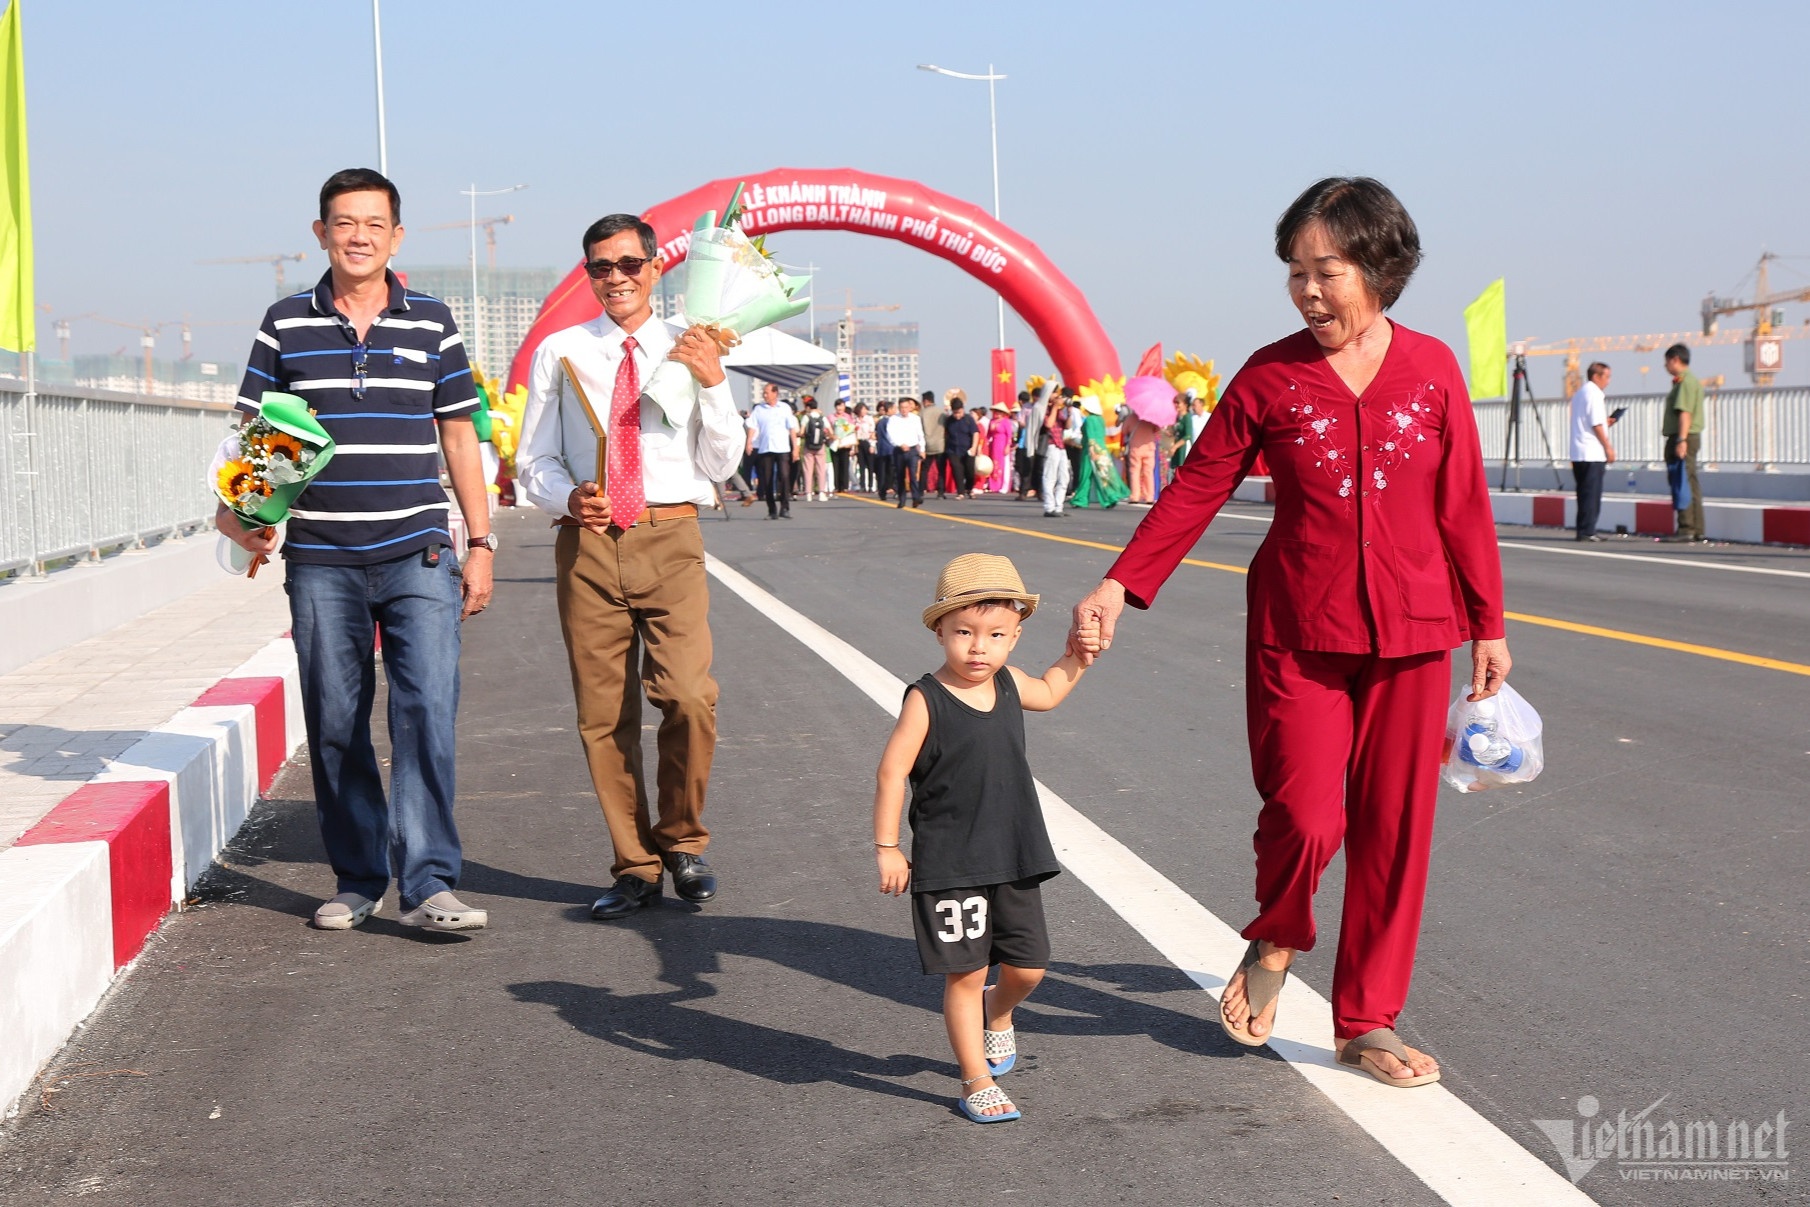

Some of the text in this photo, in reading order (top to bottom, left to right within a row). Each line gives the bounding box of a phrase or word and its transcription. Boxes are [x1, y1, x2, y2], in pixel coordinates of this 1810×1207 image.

[766, 181, 826, 205] KHÁNH
[829, 183, 887, 210] THÀNH
[757, 206, 804, 227] LONG
[900, 216, 939, 241] PHỐ
[938, 228, 974, 255] THỦ
[970, 244, 1008, 274] ĐỨC
[935, 895, 988, 943] 33
